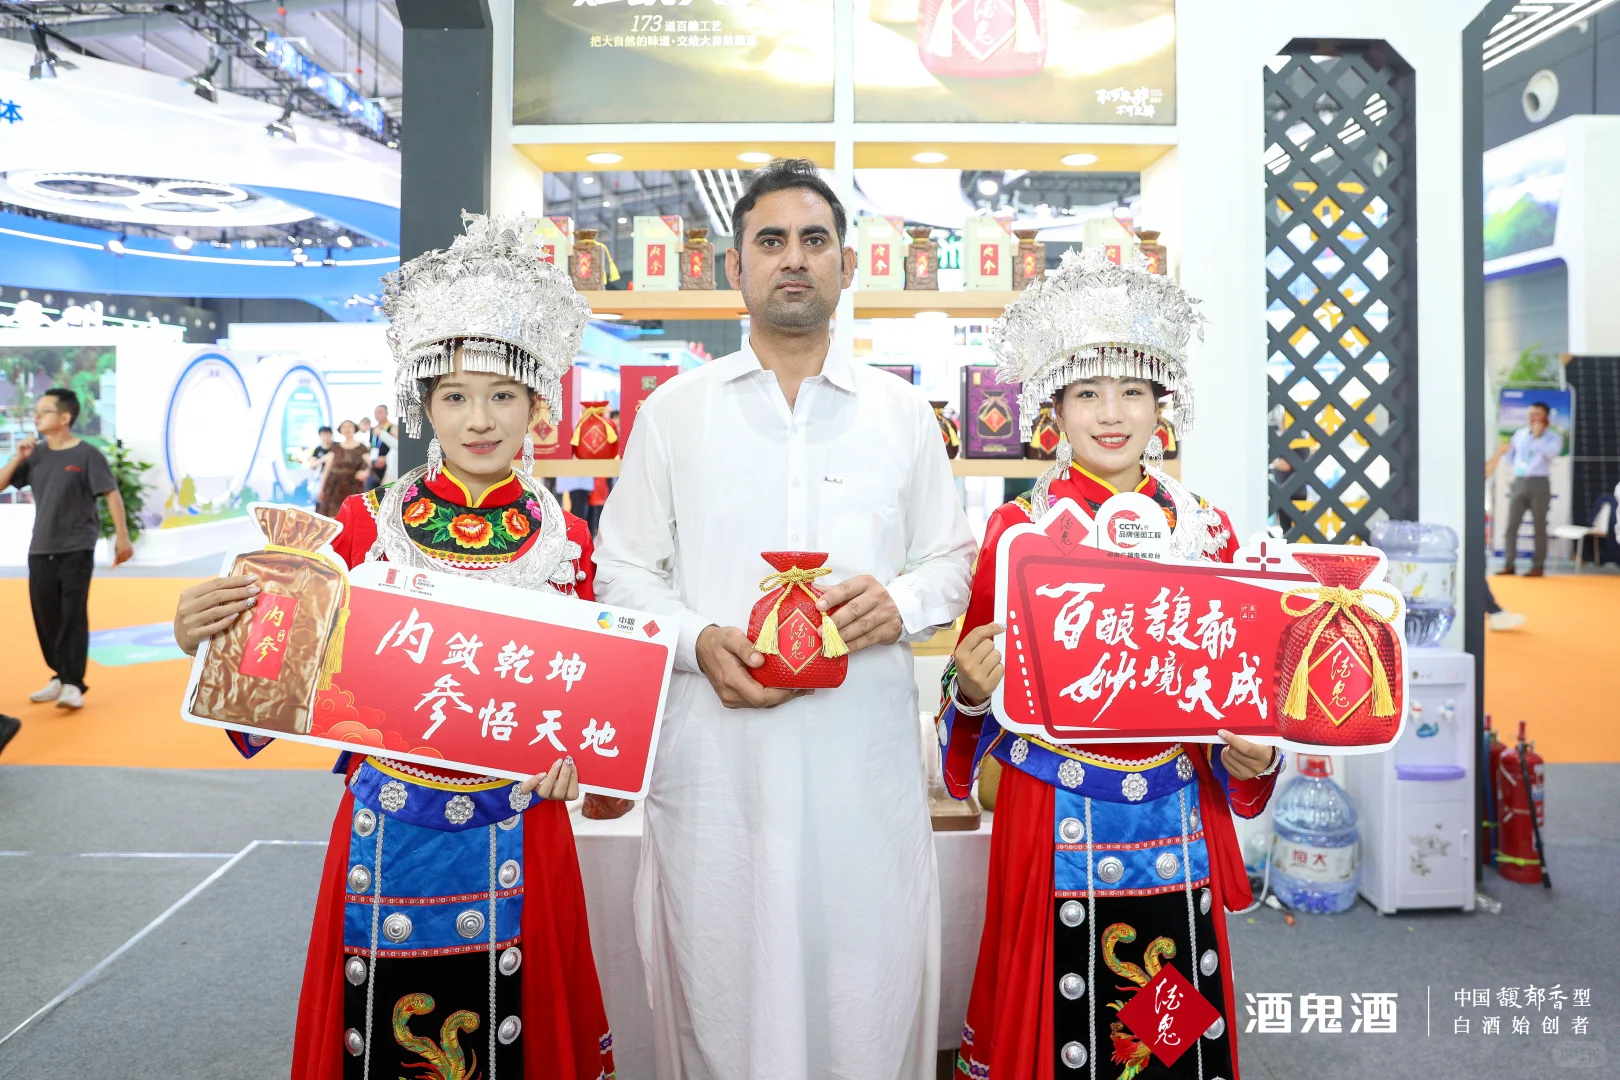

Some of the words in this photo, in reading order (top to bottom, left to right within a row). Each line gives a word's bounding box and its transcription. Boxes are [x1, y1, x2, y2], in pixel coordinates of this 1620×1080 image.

[629, 14, 662, 32] 173
[1107, 551, 1161, 560] 中央广播电视总台
[1118, 530, 1162, 539] 品牌强国工程
[254, 604, 285, 663] 内参
[375, 607, 587, 693] 内敛乾坤
[617, 623, 634, 632] COFCO
[1035, 582, 1237, 660] 百酿馥郁
[1059, 650, 1268, 723] 妙境天成
[1328, 649, 1354, 708] 酒鬼
[413, 673, 620, 758] 参悟天地
[1293, 849, 1327, 867] 恒大
